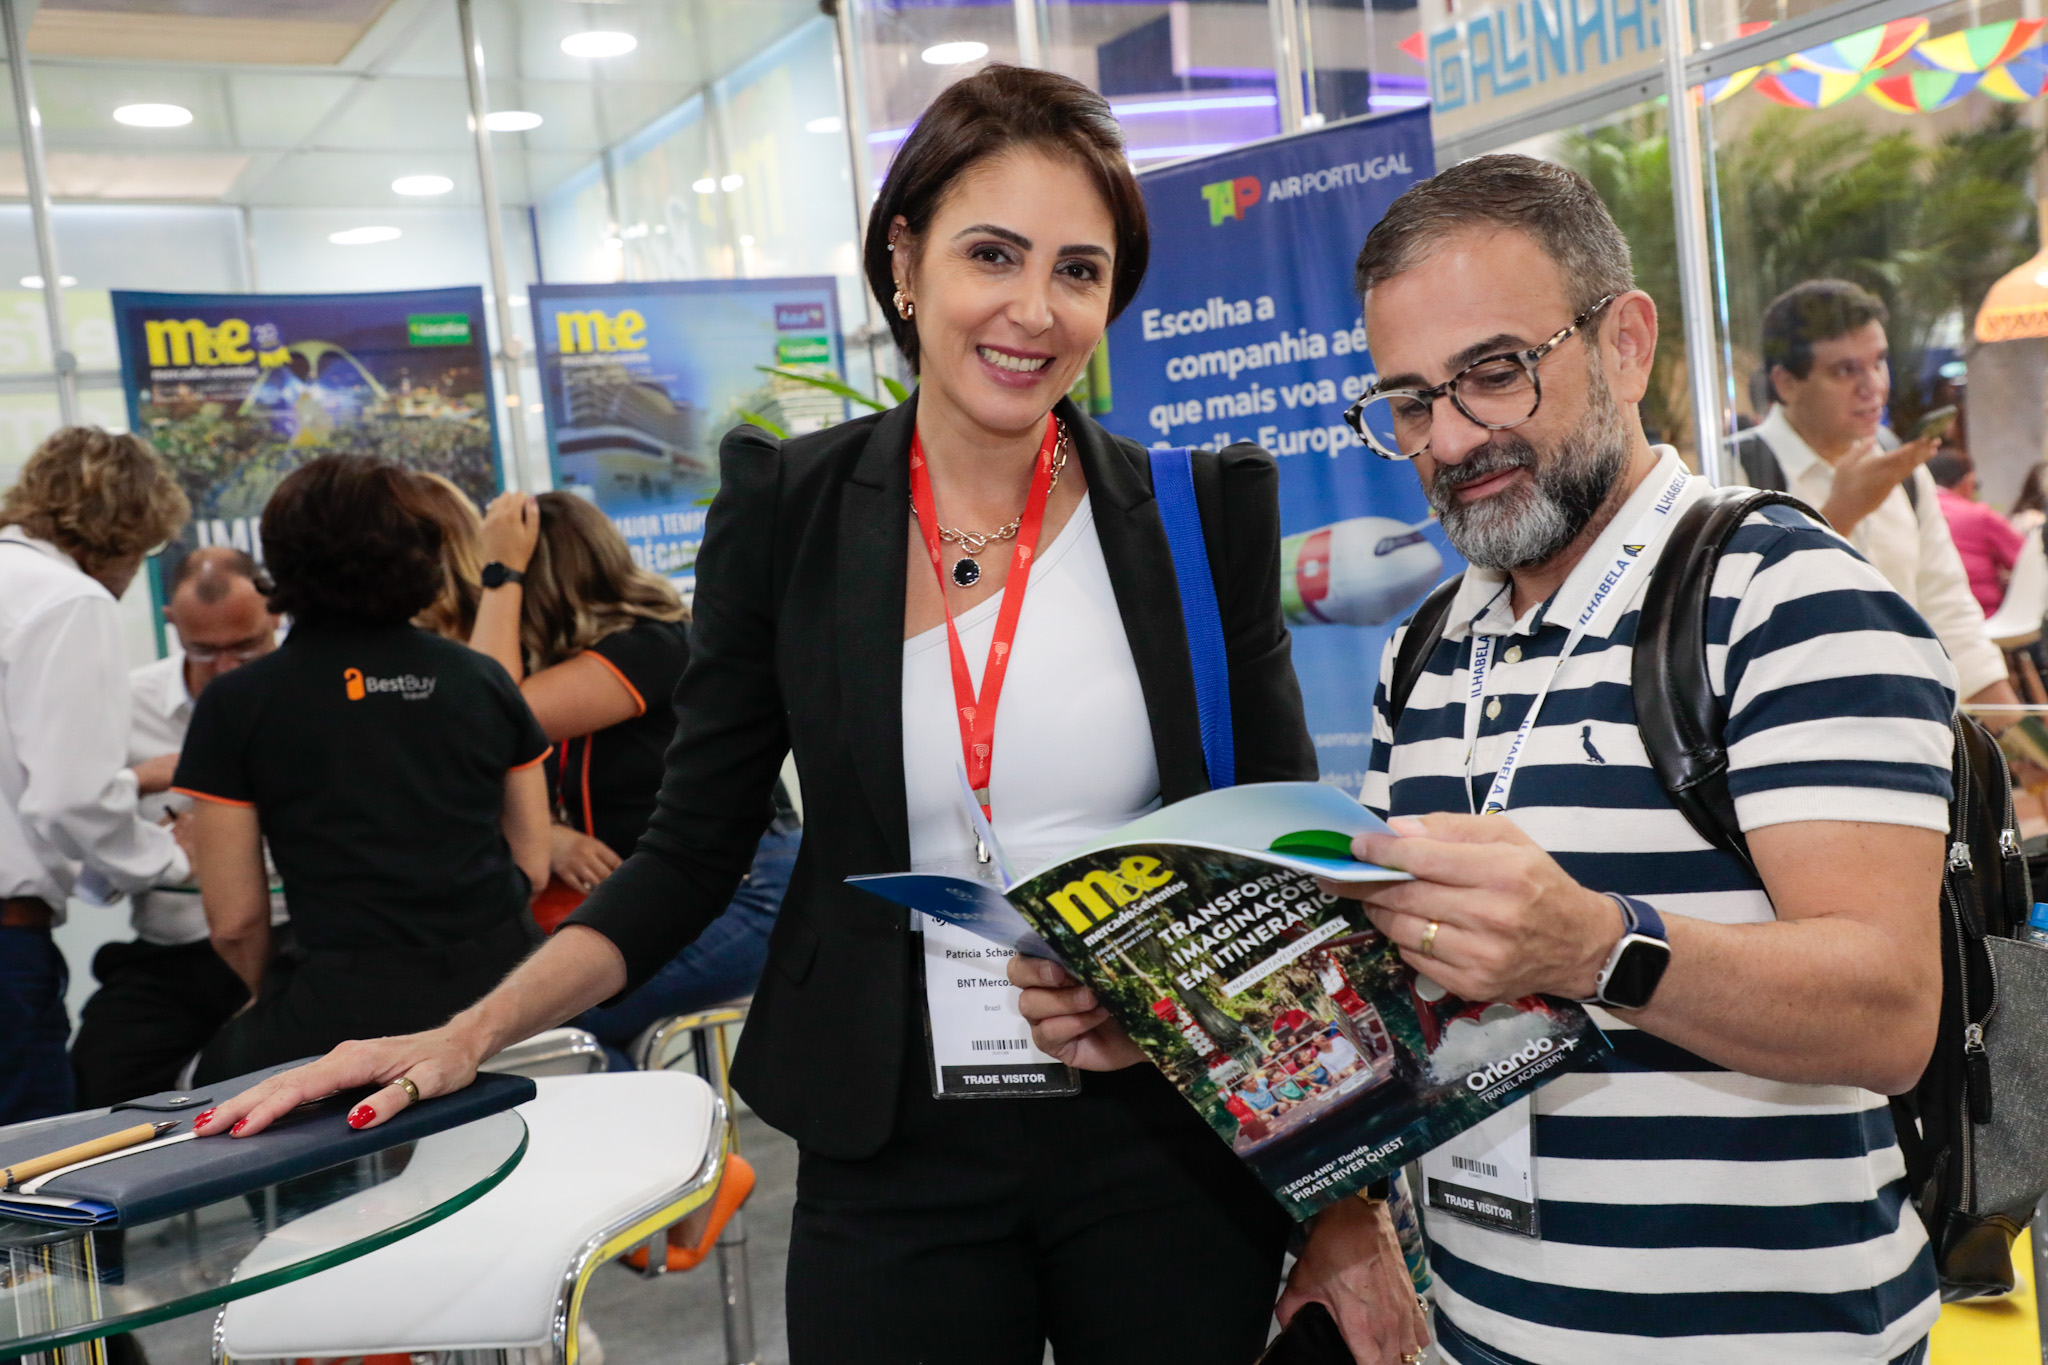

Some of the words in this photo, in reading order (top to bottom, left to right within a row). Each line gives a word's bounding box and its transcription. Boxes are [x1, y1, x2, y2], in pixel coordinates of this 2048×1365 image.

[1201, 175, 1262, 226] TAP
[1141, 296, 1253, 341] Escolha
[1256, 295, 1276, 321] a
[1165, 328, 1329, 382] companhia
[1149, 397, 1204, 436] que
[1206, 382, 1278, 421] mais
[1280, 378, 1338, 410] voa
[1578, 558, 1631, 627] ILHABELA
[1471, 634, 1491, 698] ILHABELA
[1046, 855, 1175, 935] m&e
[1083, 880, 1189, 948] mercado&eventos
[1176, 962, 1216, 991] EM
[1229, 932, 1320, 992] INACREDITAVELMENTE
[1319, 921, 1344, 937] REAL
[957, 978, 976, 988] BNT
[984, 1003, 1001, 1012] Brazil
[963, 1074, 1000, 1085] TRADE
[1001, 1073, 1047, 1084] VISITOR
[1466, 1036, 1554, 1092] Orlando
[1481, 1080, 1519, 1104] TRAVEL
[1291, 1173, 1335, 1203] PIRATE
[1332, 1157, 1368, 1183] RIVER
[1366, 1136, 1406, 1165] QUEST
[1337, 1144, 1370, 1165] Florida
[1444, 1192, 1475, 1210] TRADE
[1476, 1200, 1513, 1221] VISITOR
